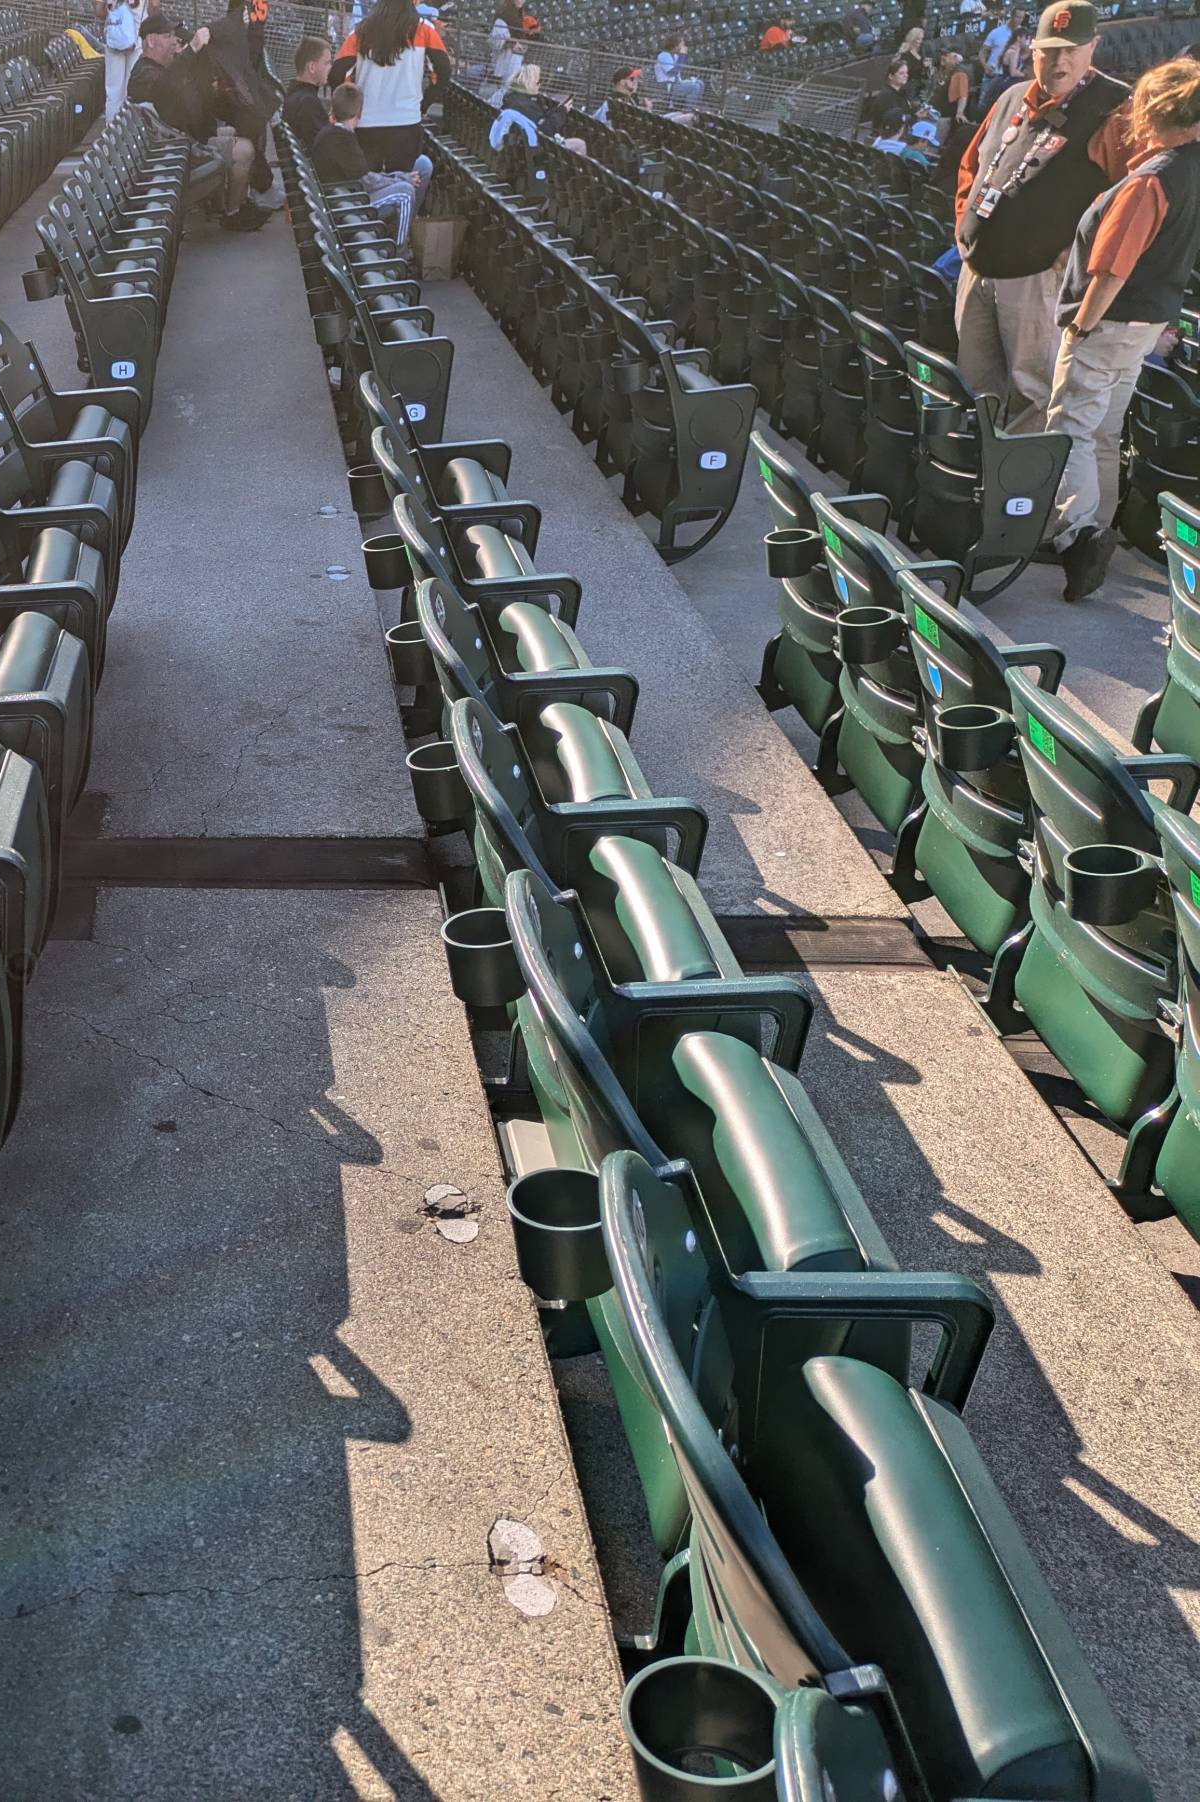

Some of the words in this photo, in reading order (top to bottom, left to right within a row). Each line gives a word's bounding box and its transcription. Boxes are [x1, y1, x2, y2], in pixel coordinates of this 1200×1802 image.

[965, 21, 979, 33] blue
[119, 364, 128, 376] H
[409, 407, 418, 418] G
[709, 455, 718, 466] F
[1015, 501, 1025, 512] E
